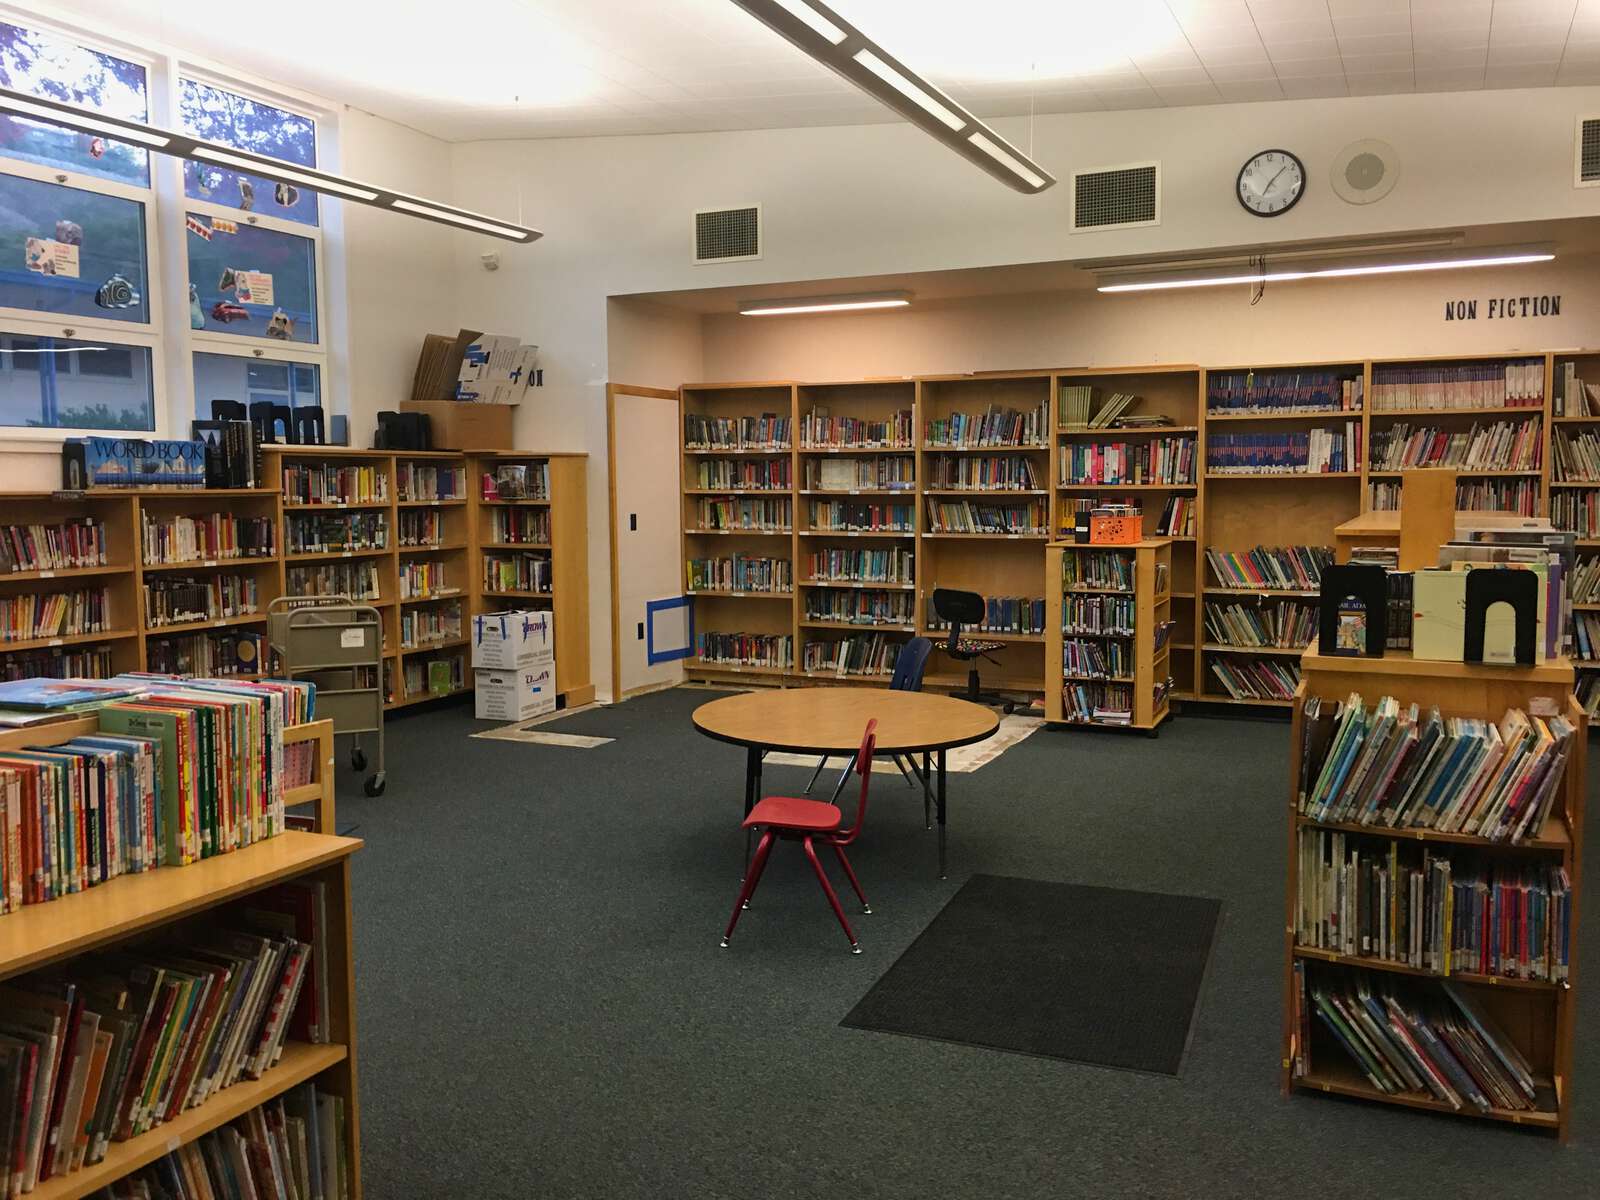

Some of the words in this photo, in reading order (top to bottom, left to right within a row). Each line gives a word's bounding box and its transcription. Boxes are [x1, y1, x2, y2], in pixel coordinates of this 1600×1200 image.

[1266, 154, 1273, 162] 12
[1290, 163, 1296, 171] 2
[1445, 299, 1477, 321] NON
[1488, 295, 1561, 319] FICTION
[94, 439, 154, 459] WORLD
[158, 442, 203, 460] BOOK
